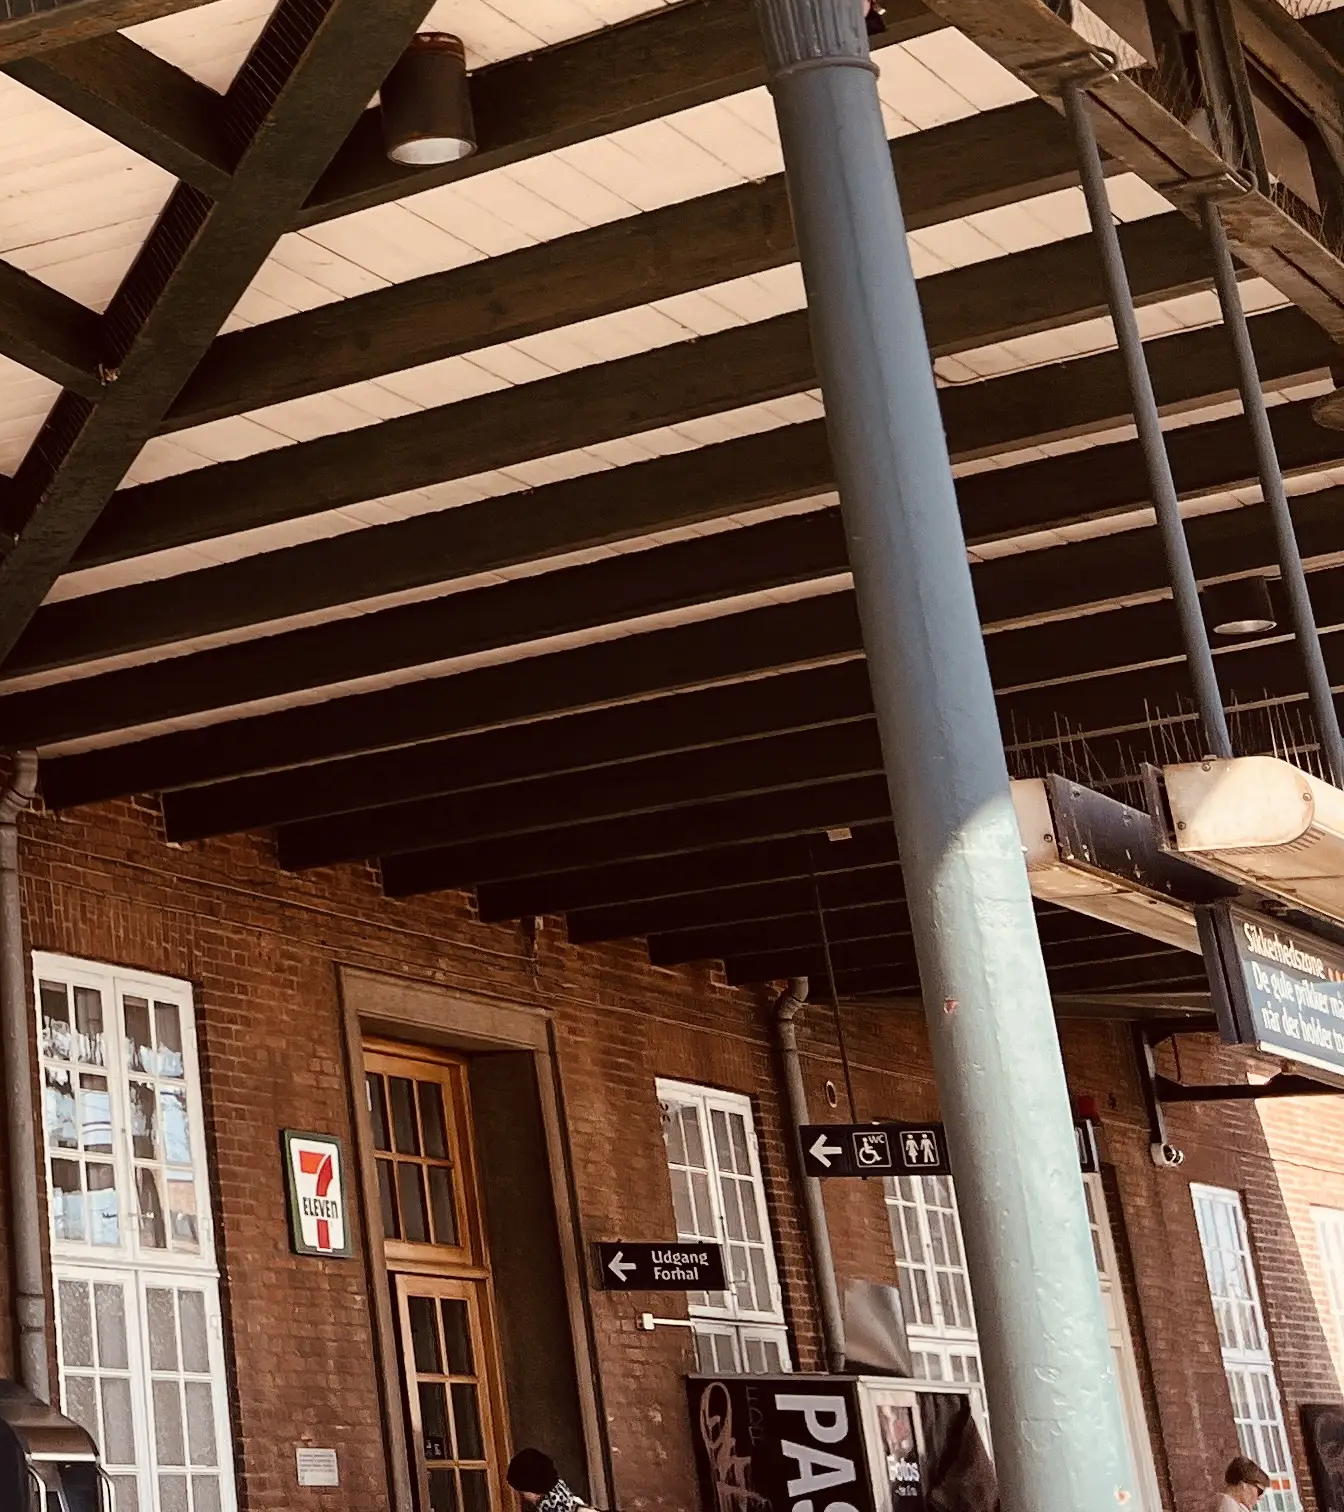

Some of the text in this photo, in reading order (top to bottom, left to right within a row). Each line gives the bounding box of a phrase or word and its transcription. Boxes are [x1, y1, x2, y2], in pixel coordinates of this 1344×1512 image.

[1244, 922, 1326, 979] Sikkerhedszone
[1252, 961, 1271, 994] De
[1271, 970, 1295, 1003] gule
[1294, 979, 1330, 1015] prikker
[1261, 1000, 1281, 1033] når
[1281, 1007, 1301, 1040] der
[1298, 1011, 1333, 1049] holder
[867, 1134, 886, 1144] WC
[299, 1150, 333, 1249] 7
[651, 1250, 709, 1266] Udgang
[653, 1266, 699, 1281] Forhal
[774, 1393, 860, 1512] PA
